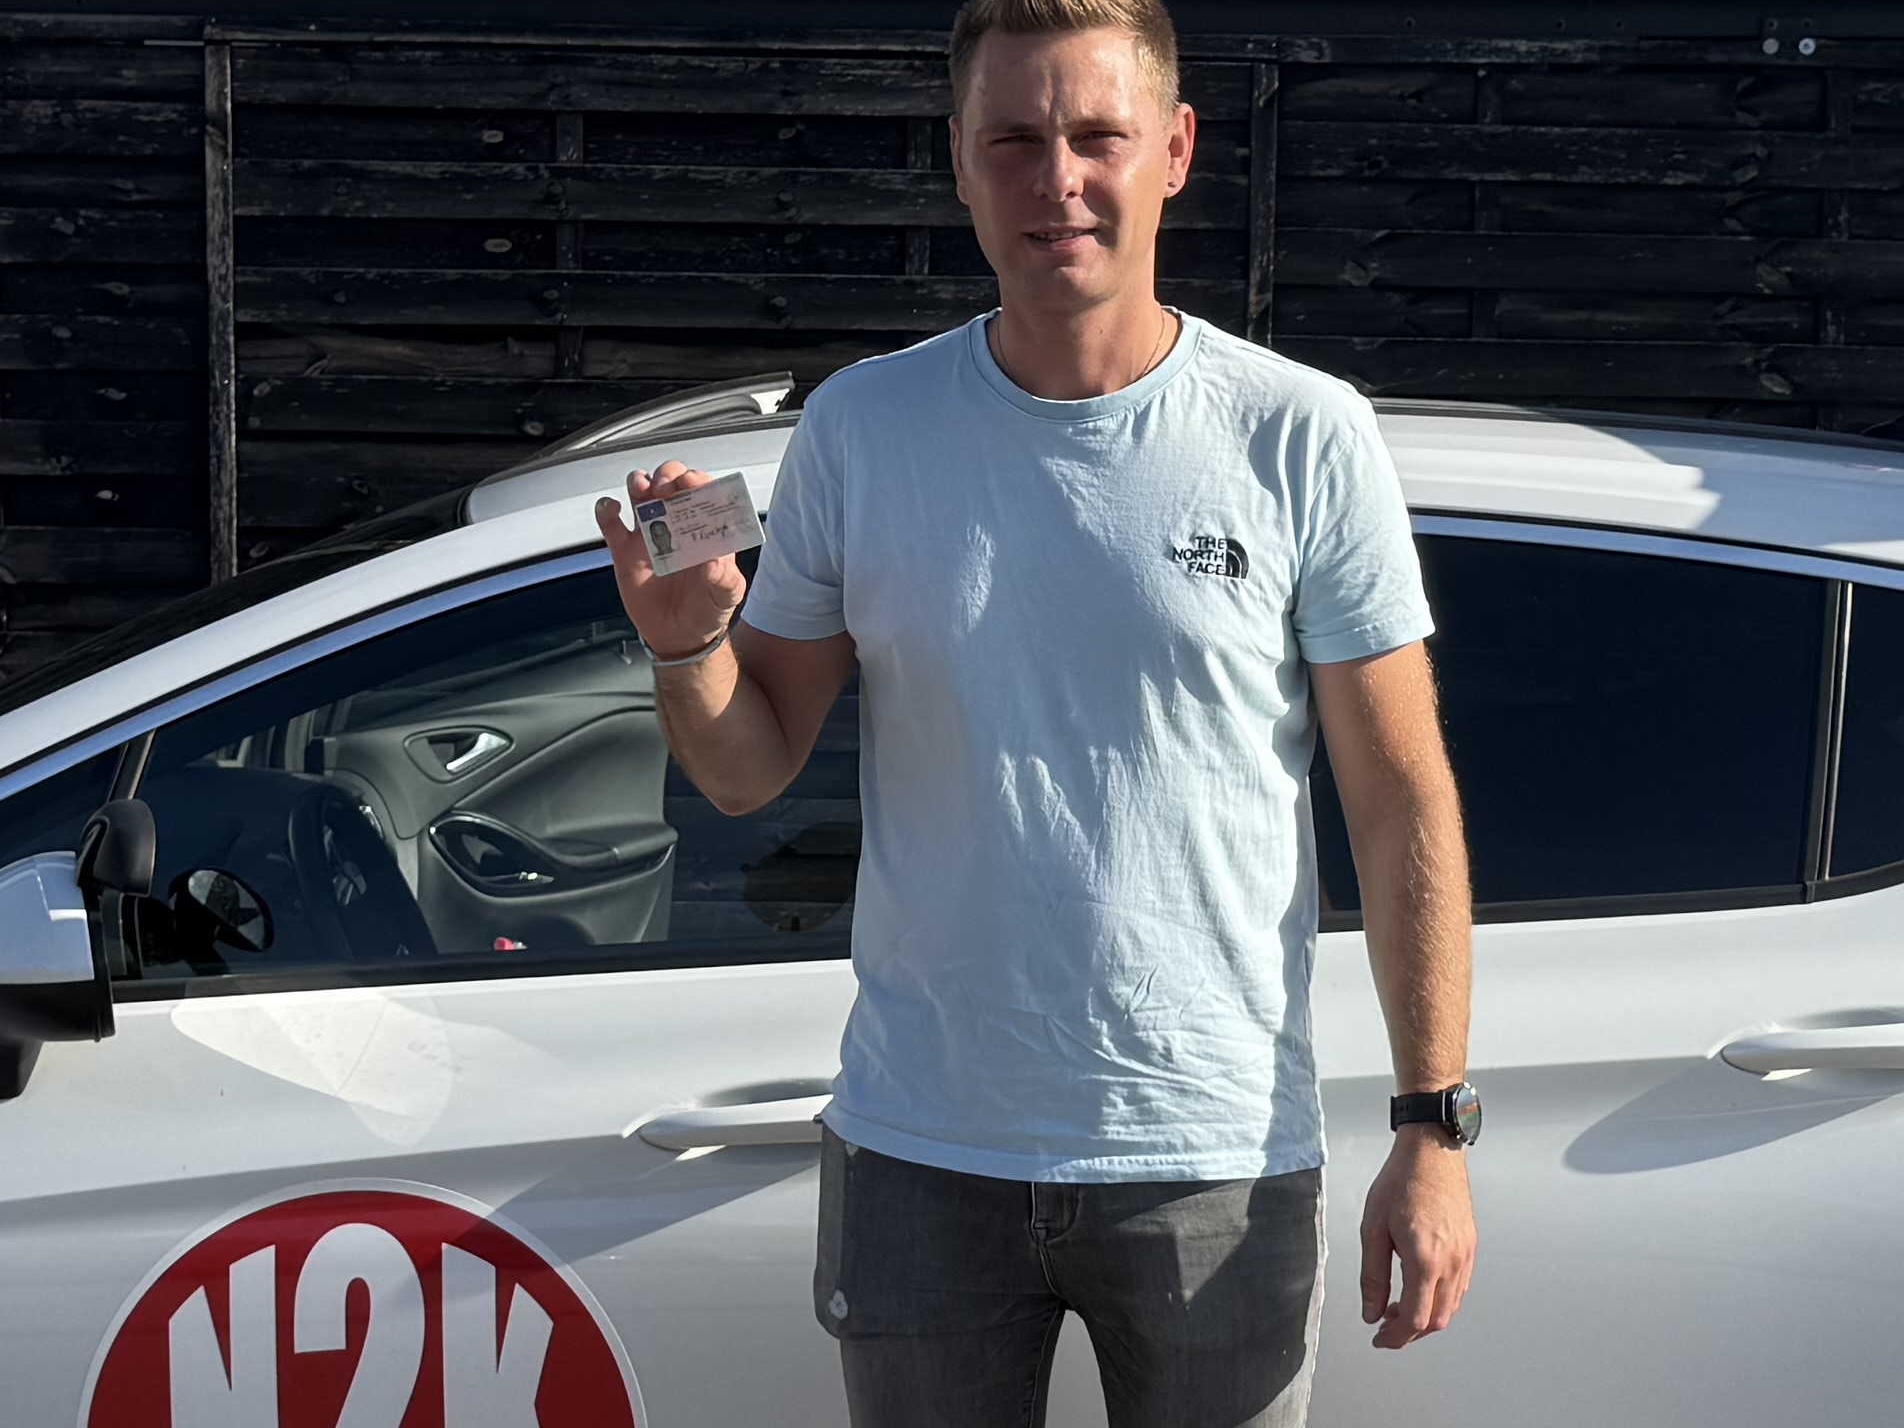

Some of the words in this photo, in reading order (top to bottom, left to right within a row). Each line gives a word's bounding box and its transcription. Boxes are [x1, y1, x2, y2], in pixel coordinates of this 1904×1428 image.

[1195, 536, 1226, 549] THE
[1172, 547, 1225, 562] NORTH
[1187, 561, 1226, 576] FACE
